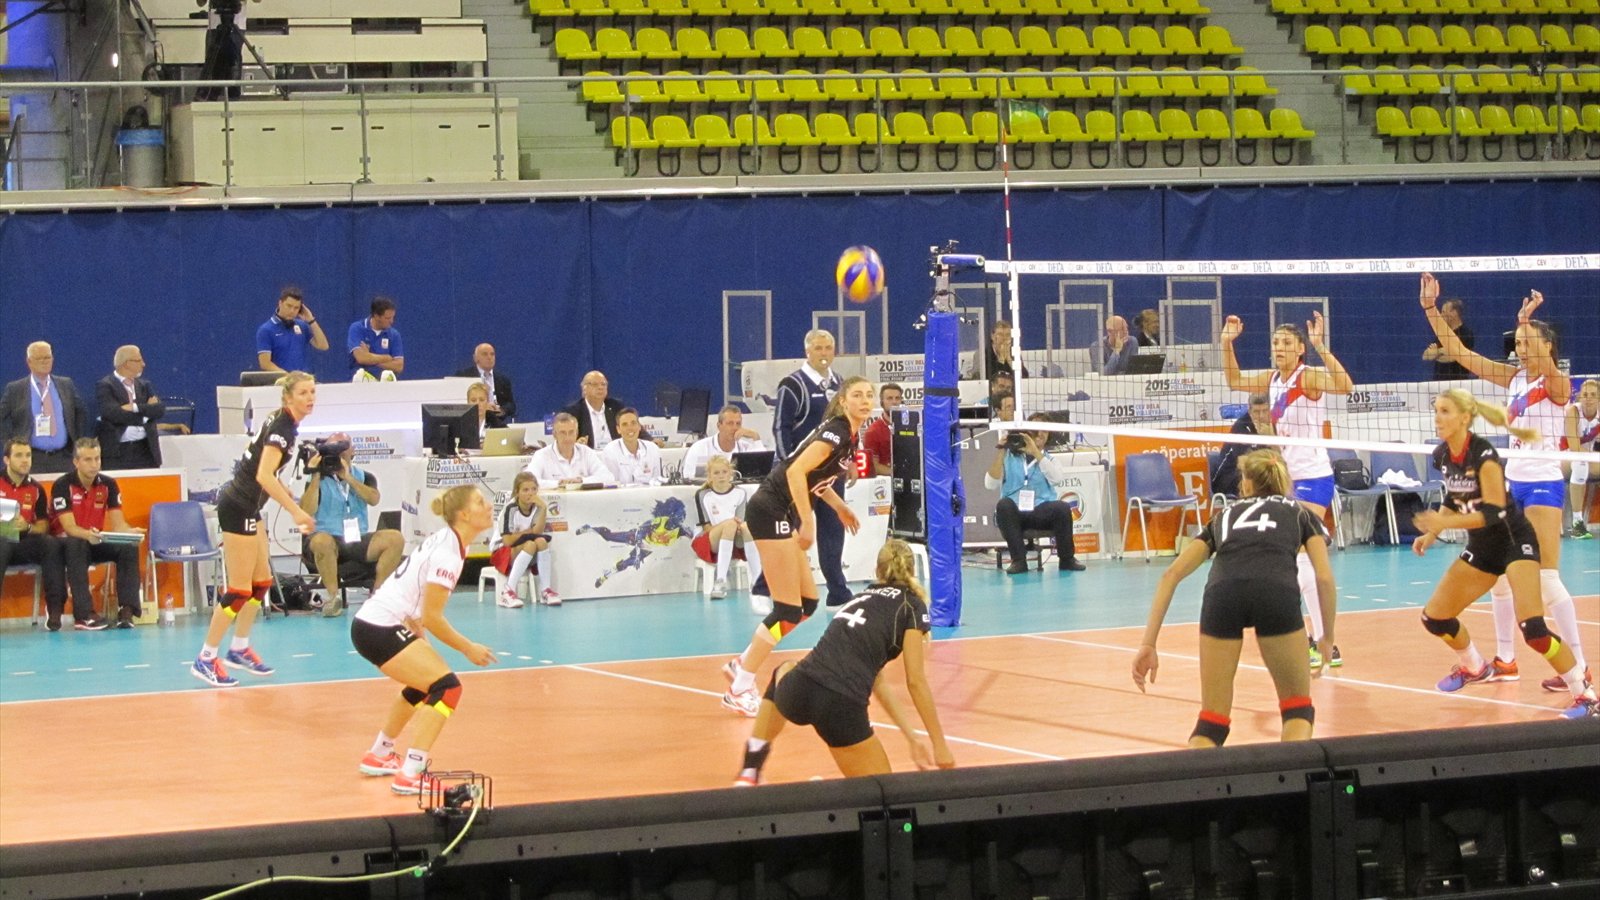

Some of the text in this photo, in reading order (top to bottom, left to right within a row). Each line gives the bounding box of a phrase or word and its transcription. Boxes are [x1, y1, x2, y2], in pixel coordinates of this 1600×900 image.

[880, 361, 904, 372] 2015
[1146, 379, 1170, 391] 2015
[1347, 392, 1371, 404] 2015
[1110, 405, 1135, 417] 2015
[427, 459, 441, 471] 2015
[244, 519, 257, 534] 12
[776, 521, 790, 534] 18
[1222, 501, 1277, 542] 14
[833, 595, 867, 628] 4
